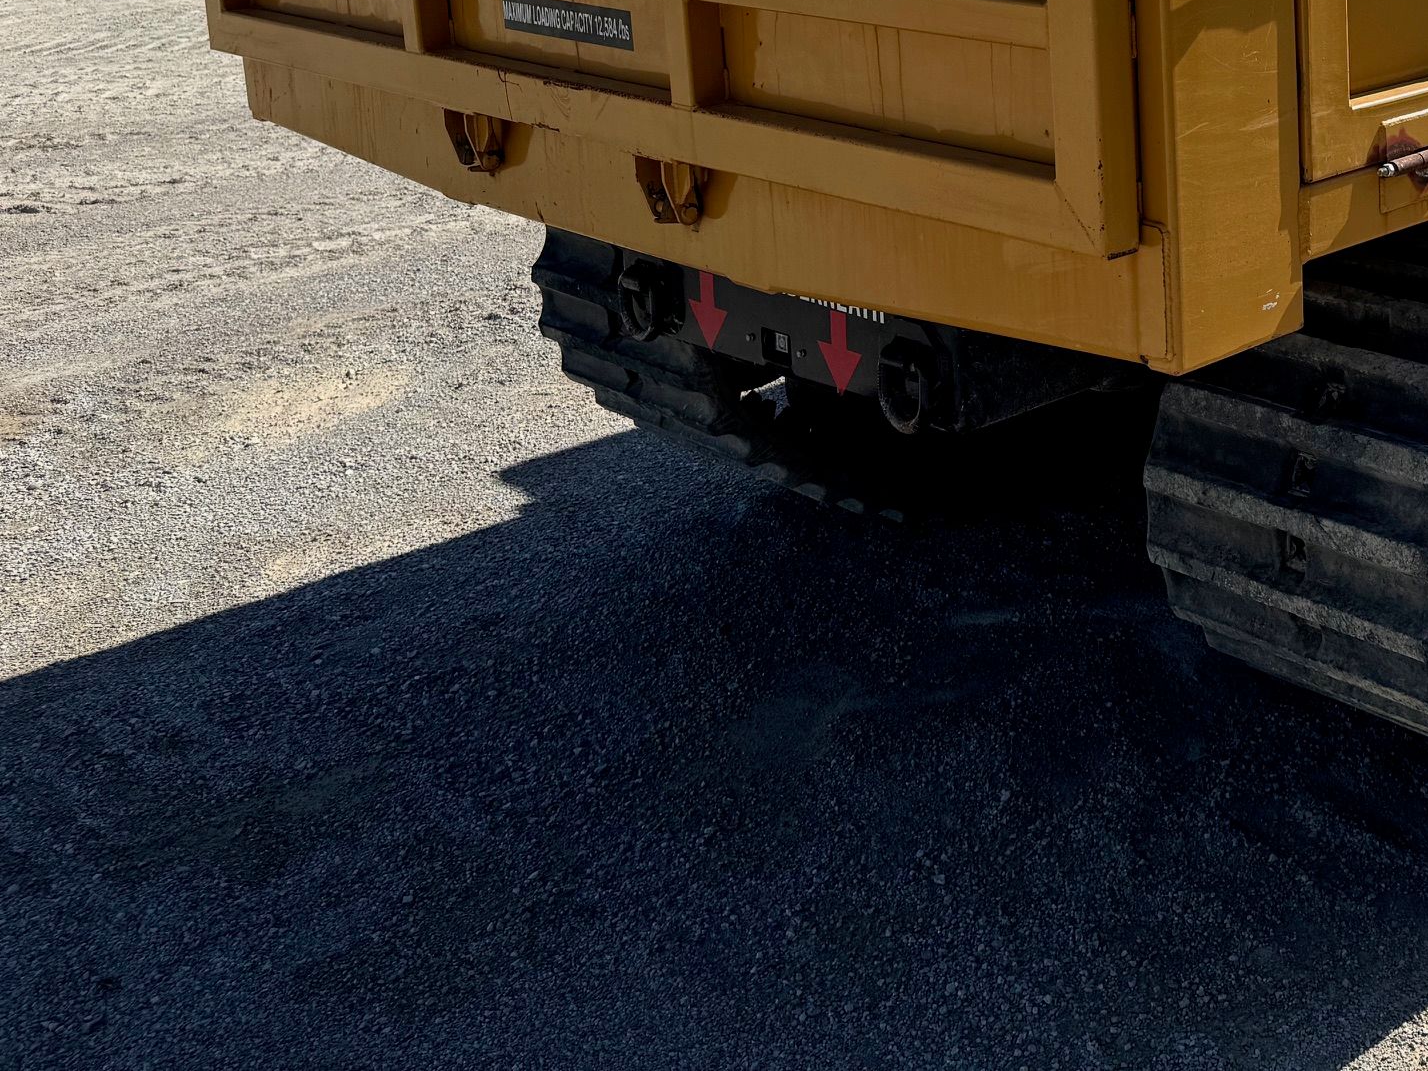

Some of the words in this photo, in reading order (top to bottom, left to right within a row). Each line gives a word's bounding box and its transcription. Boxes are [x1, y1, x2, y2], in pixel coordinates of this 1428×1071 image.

[502, 0, 532, 24] MAXIMUM
[532, 5, 560, 29] LOADING
[560, 10, 593, 35] CAPACITY
[594, 14, 618, 41] 12,584
